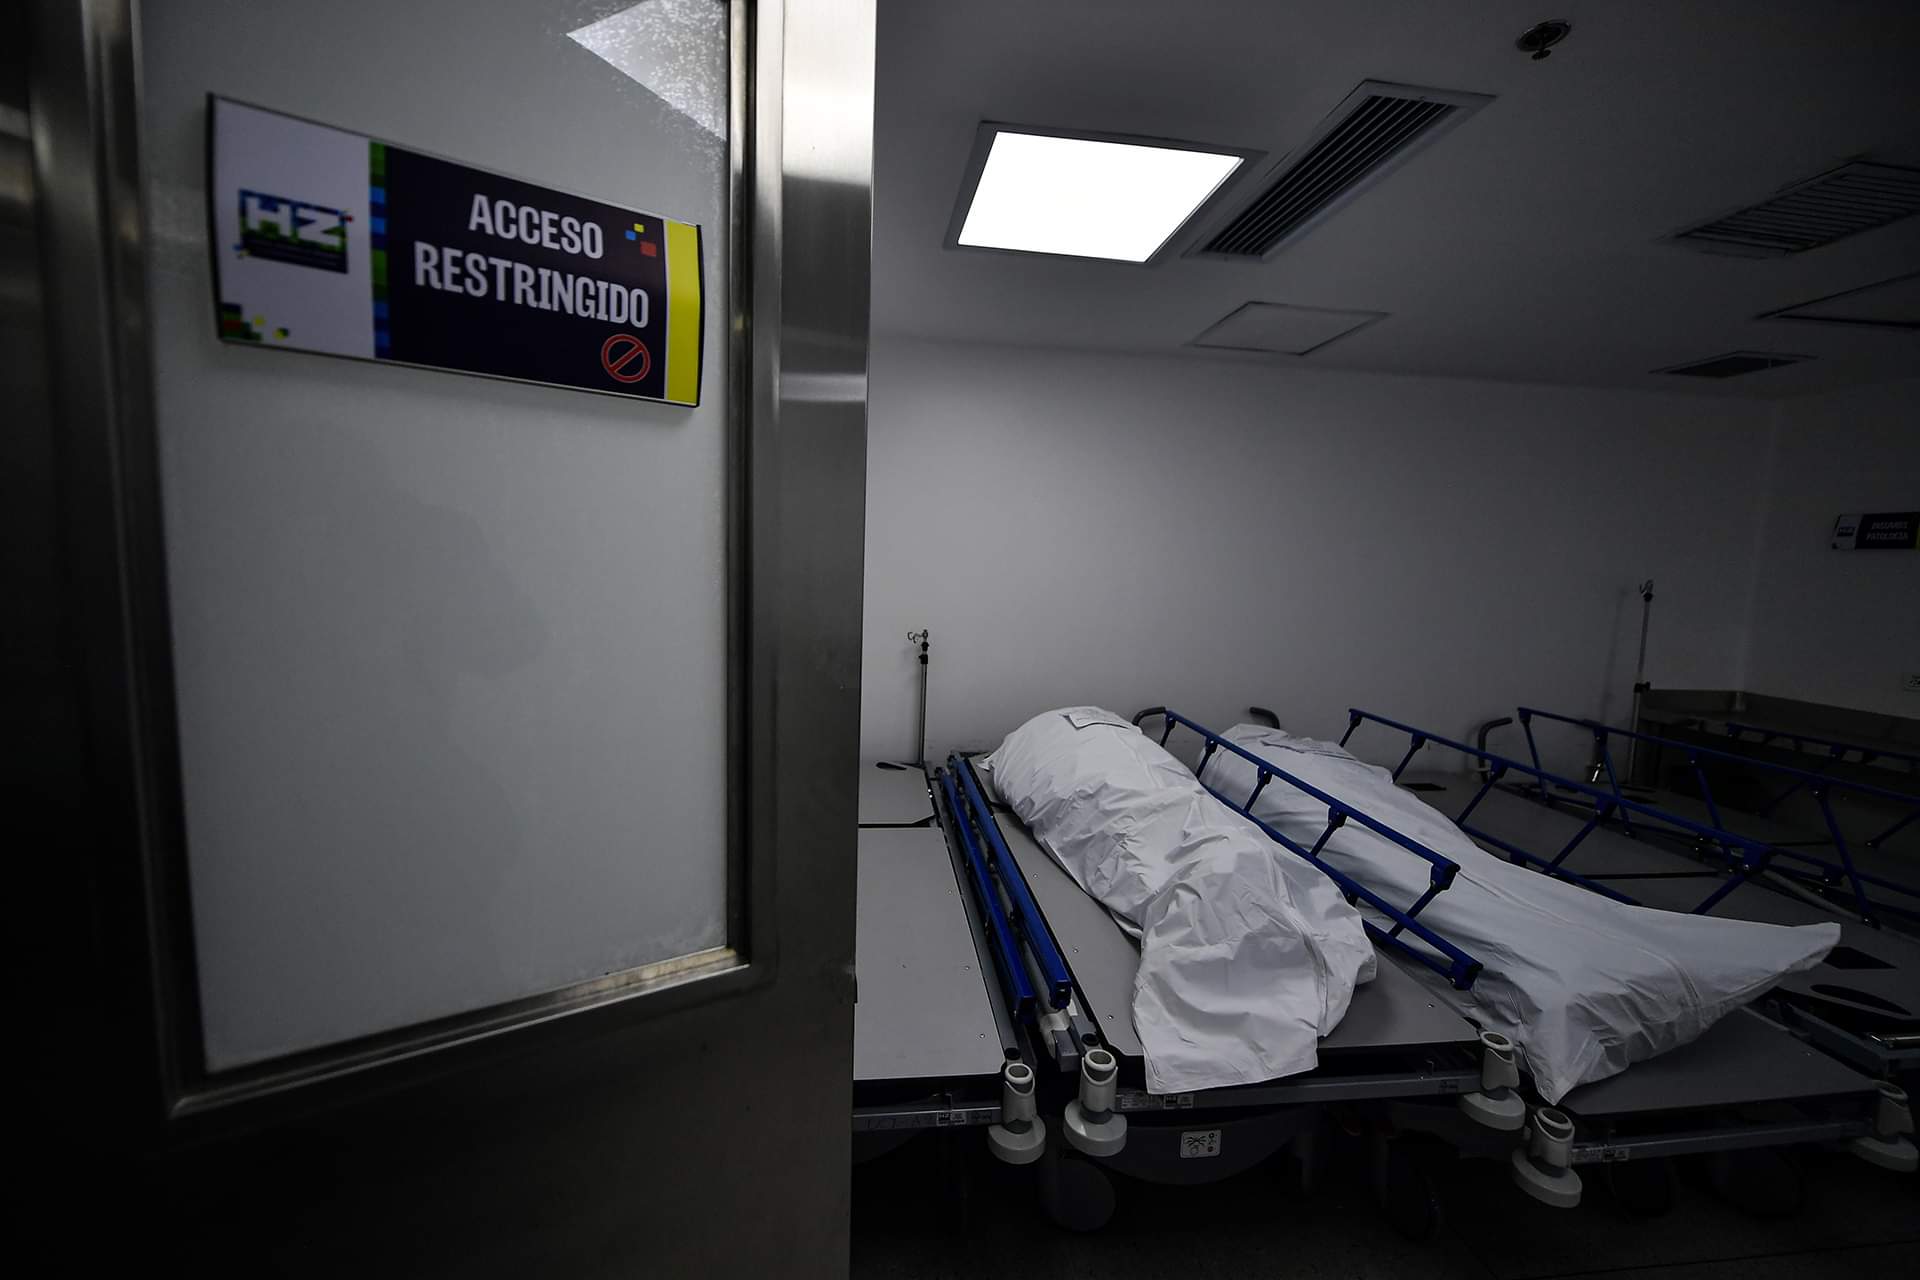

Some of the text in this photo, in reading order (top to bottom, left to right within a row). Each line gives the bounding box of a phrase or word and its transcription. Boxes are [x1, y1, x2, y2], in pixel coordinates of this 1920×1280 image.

[245, 196, 342, 247] HZ
[468, 192, 604, 260] ACCESO
[413, 241, 650, 329] RESTRINGIDO
